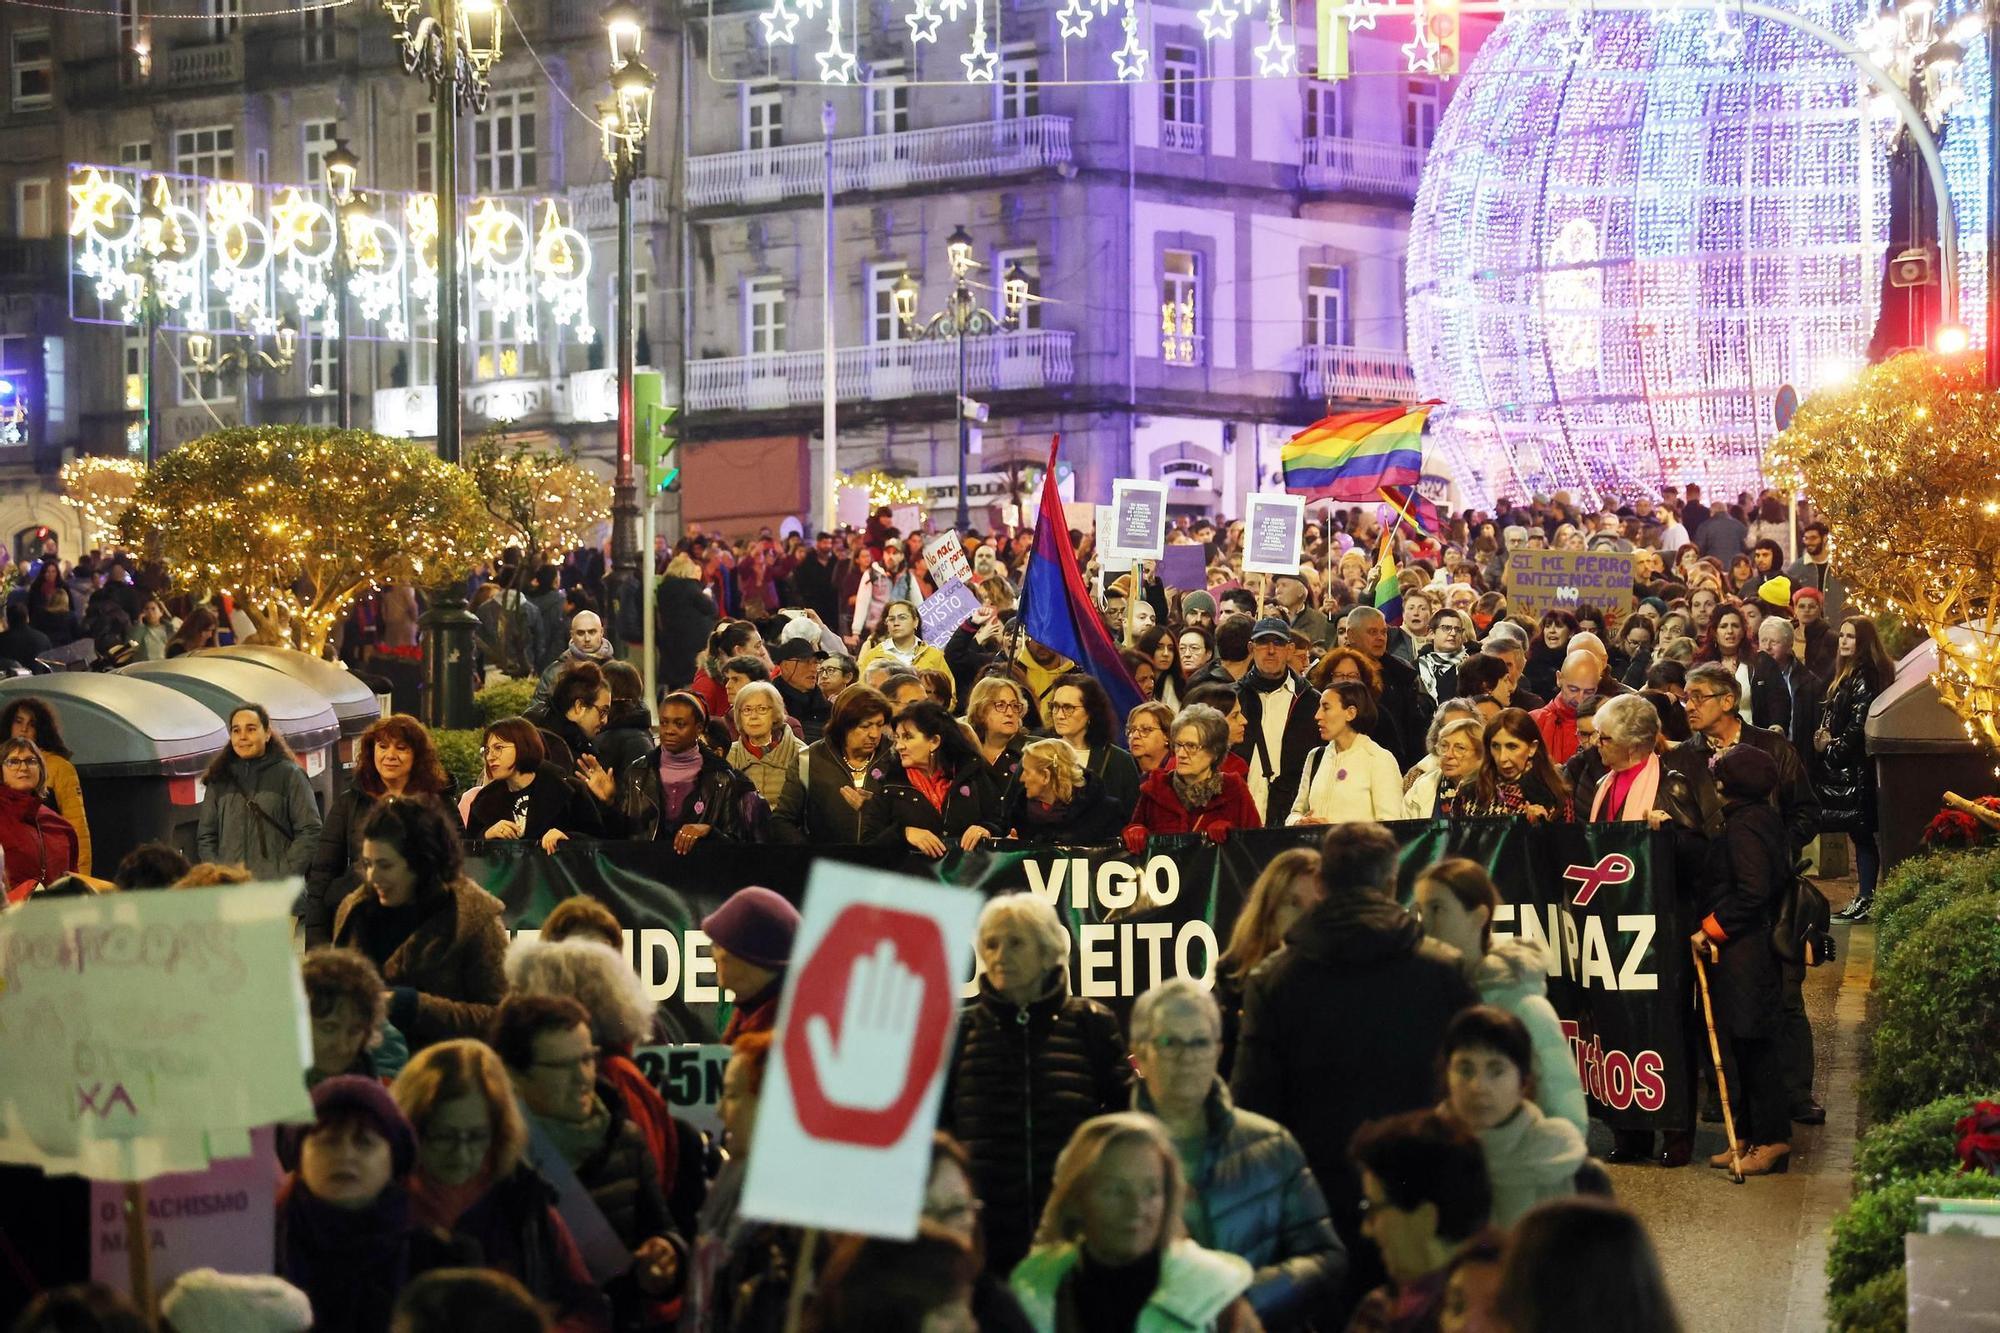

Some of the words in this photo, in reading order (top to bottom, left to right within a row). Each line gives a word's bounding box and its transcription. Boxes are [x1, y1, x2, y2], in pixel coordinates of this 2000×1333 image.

[926, 483, 1007, 498] ESTELLA
[1511, 554, 1533, 569] SI
[1541, 556, 1564, 571] MI
[1575, 555, 1632, 574] PERRO
[1516, 572, 1603, 588] ENTIENDE
[1605, 575, 1633, 588] QUE
[1512, 594, 1534, 606] TU
[1557, 585, 1579, 600] NO
[917, 592, 945, 617] ELIJO
[923, 595, 962, 628] VISTO
[1023, 854, 1180, 909] VIGO
[1562, 909, 1658, 991] PAZ
[77, 1081, 138, 1118] XA
[147, 1190, 249, 1218] ACHISMO
[101, 1229, 166, 1250] MA
